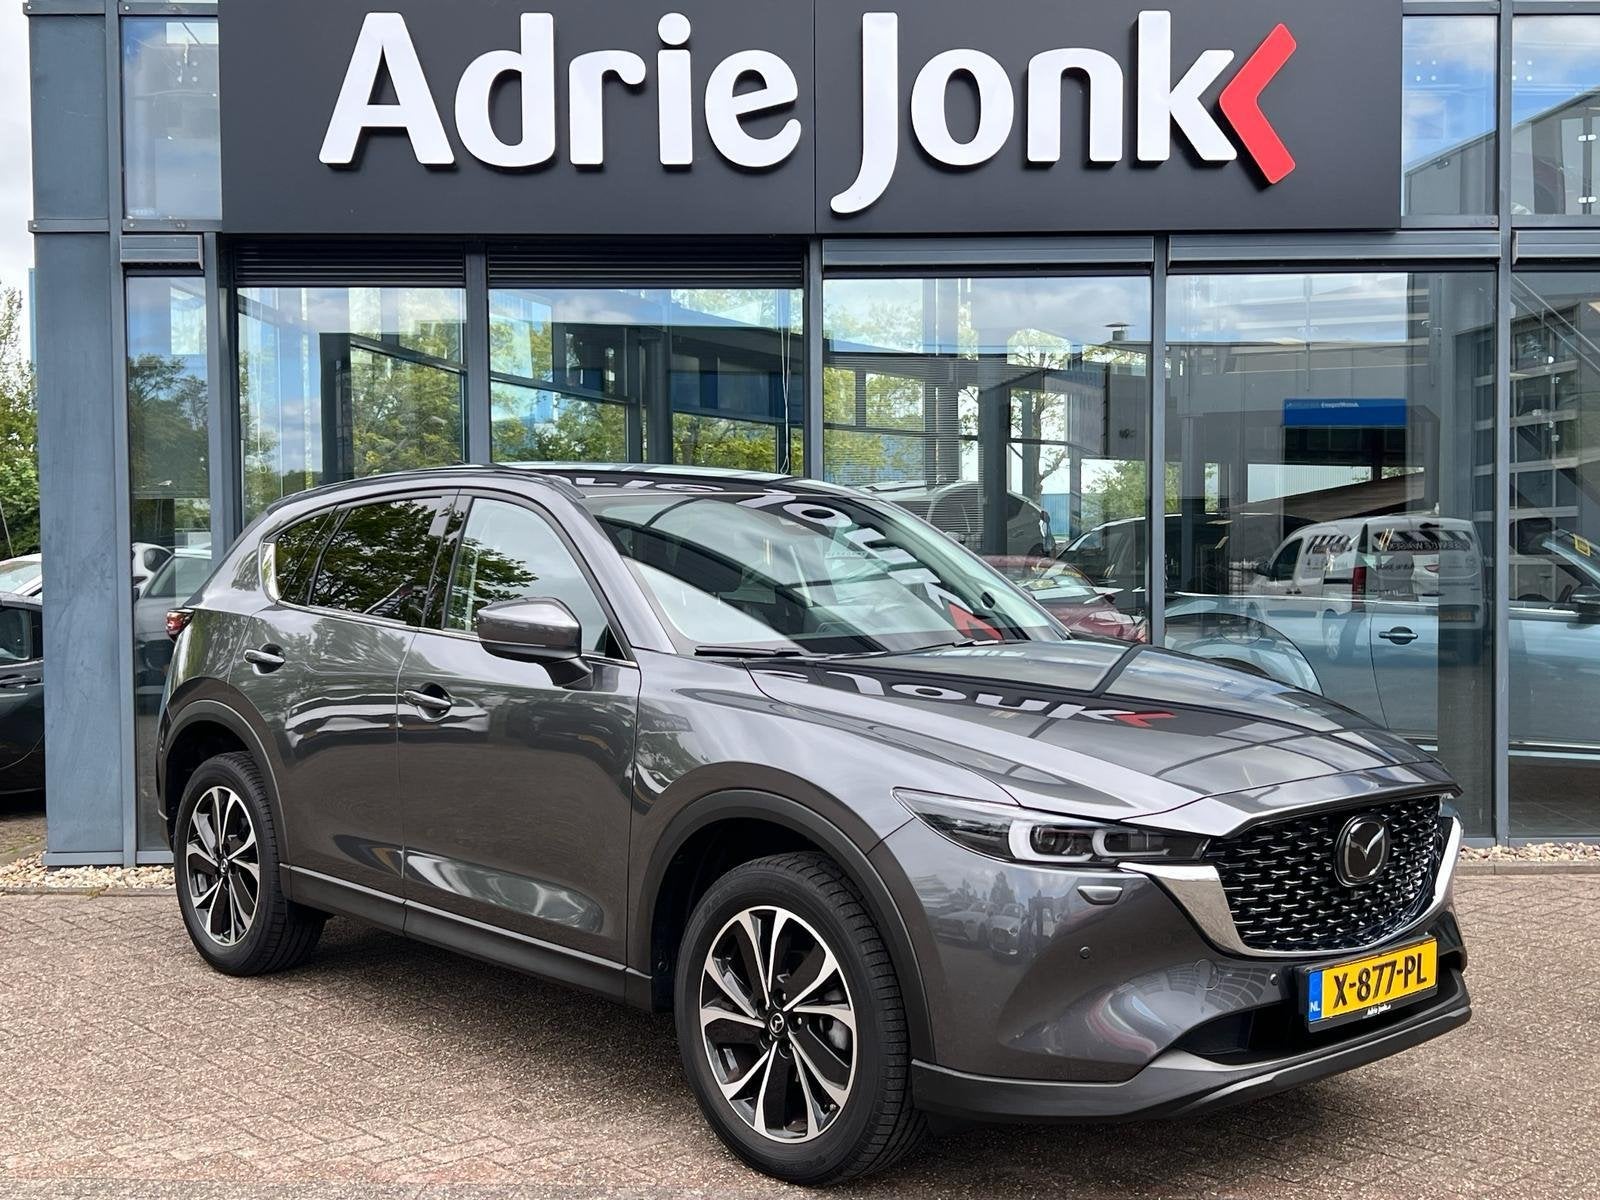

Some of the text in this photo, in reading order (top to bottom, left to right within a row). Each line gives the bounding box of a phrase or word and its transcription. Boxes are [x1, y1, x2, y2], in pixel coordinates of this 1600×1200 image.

[319, 10, 1239, 214] Adrie Jonk
[1310, 1001, 1321, 1012] NL
[1333, 953, 1427, 1009] X-877-PL
